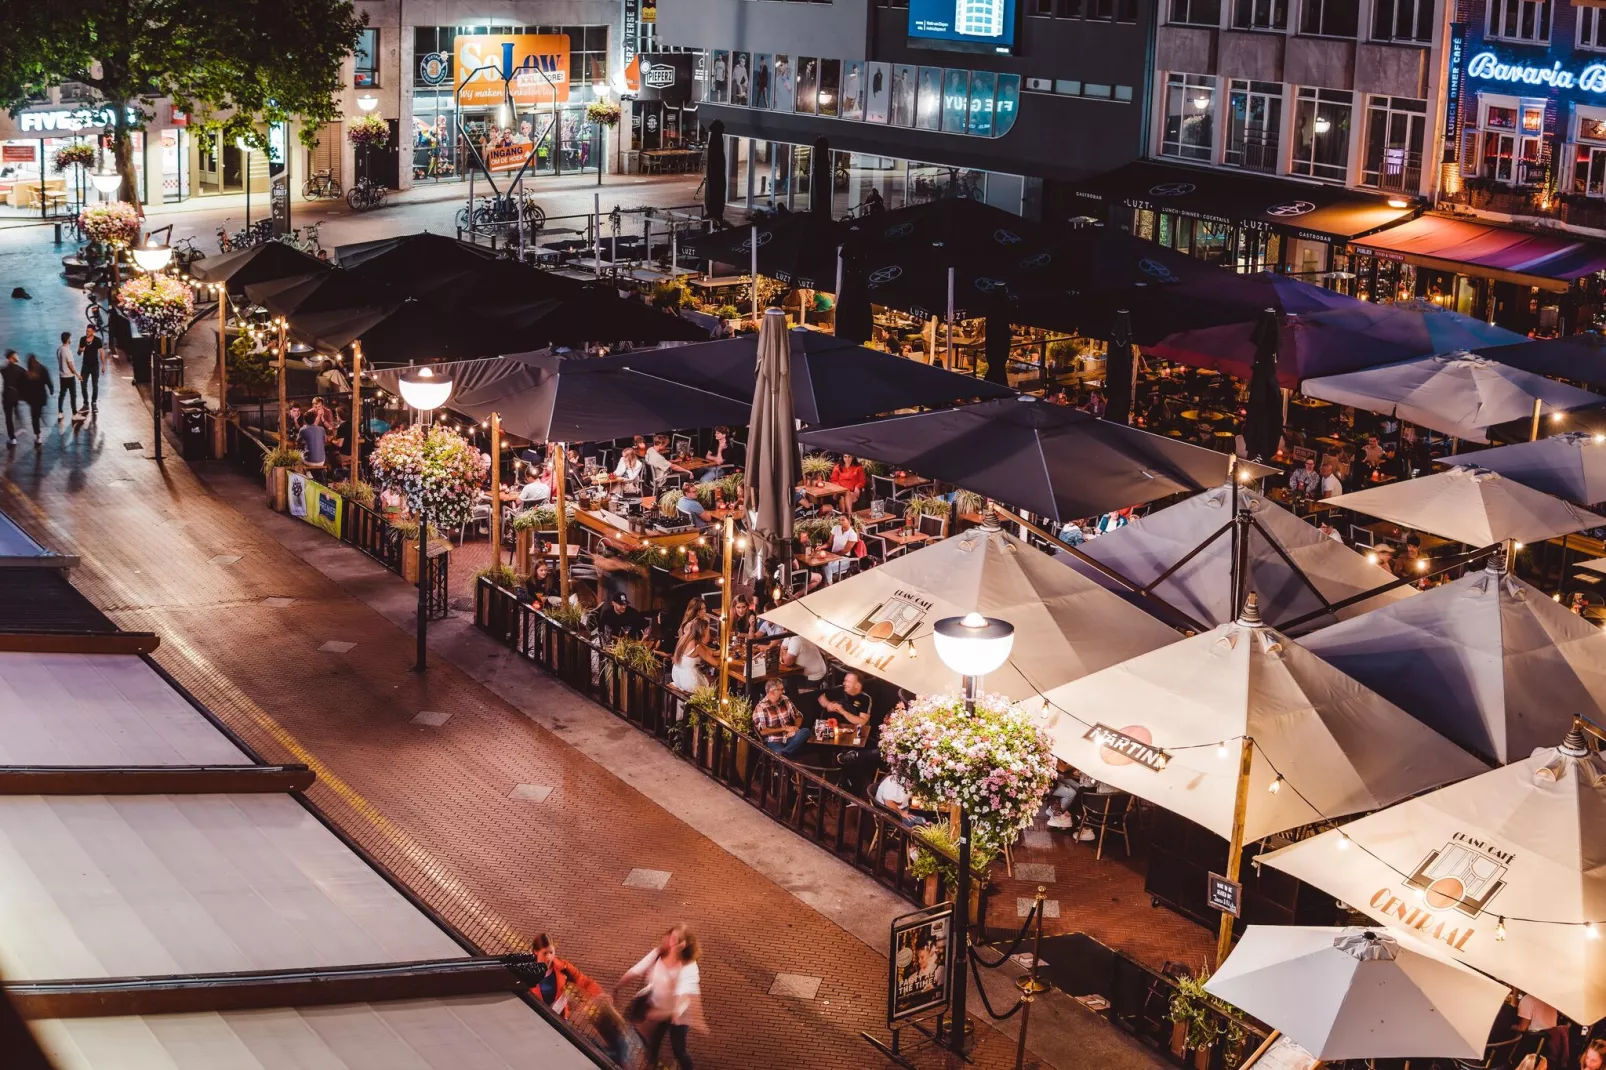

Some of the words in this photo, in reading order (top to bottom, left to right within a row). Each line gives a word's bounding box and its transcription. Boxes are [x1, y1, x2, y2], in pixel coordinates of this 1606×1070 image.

[1453, 37, 1462, 63] CAFÉ
[430, 61, 438, 76] 2
[649, 71, 673, 83] PIEPERZ
[1468, 52, 1574, 90] Bavaria
[1450, 67, 1460, 98] DINER
[460, 89, 474, 102] Wij
[474, 87, 504, 99] maken
[21, 110, 72, 132] FIVE
[1447, 102, 1457, 136] LUNCH
[490, 147, 523, 159] INGANG
[1299, 231, 1332, 243] GASTROBAR
[1452, 831, 1487, 850] GRAND
[1487, 845, 1517, 866] CAFÉ
[1369, 887, 1476, 954] CENTRAAL
[898, 983, 913, 995] THE
